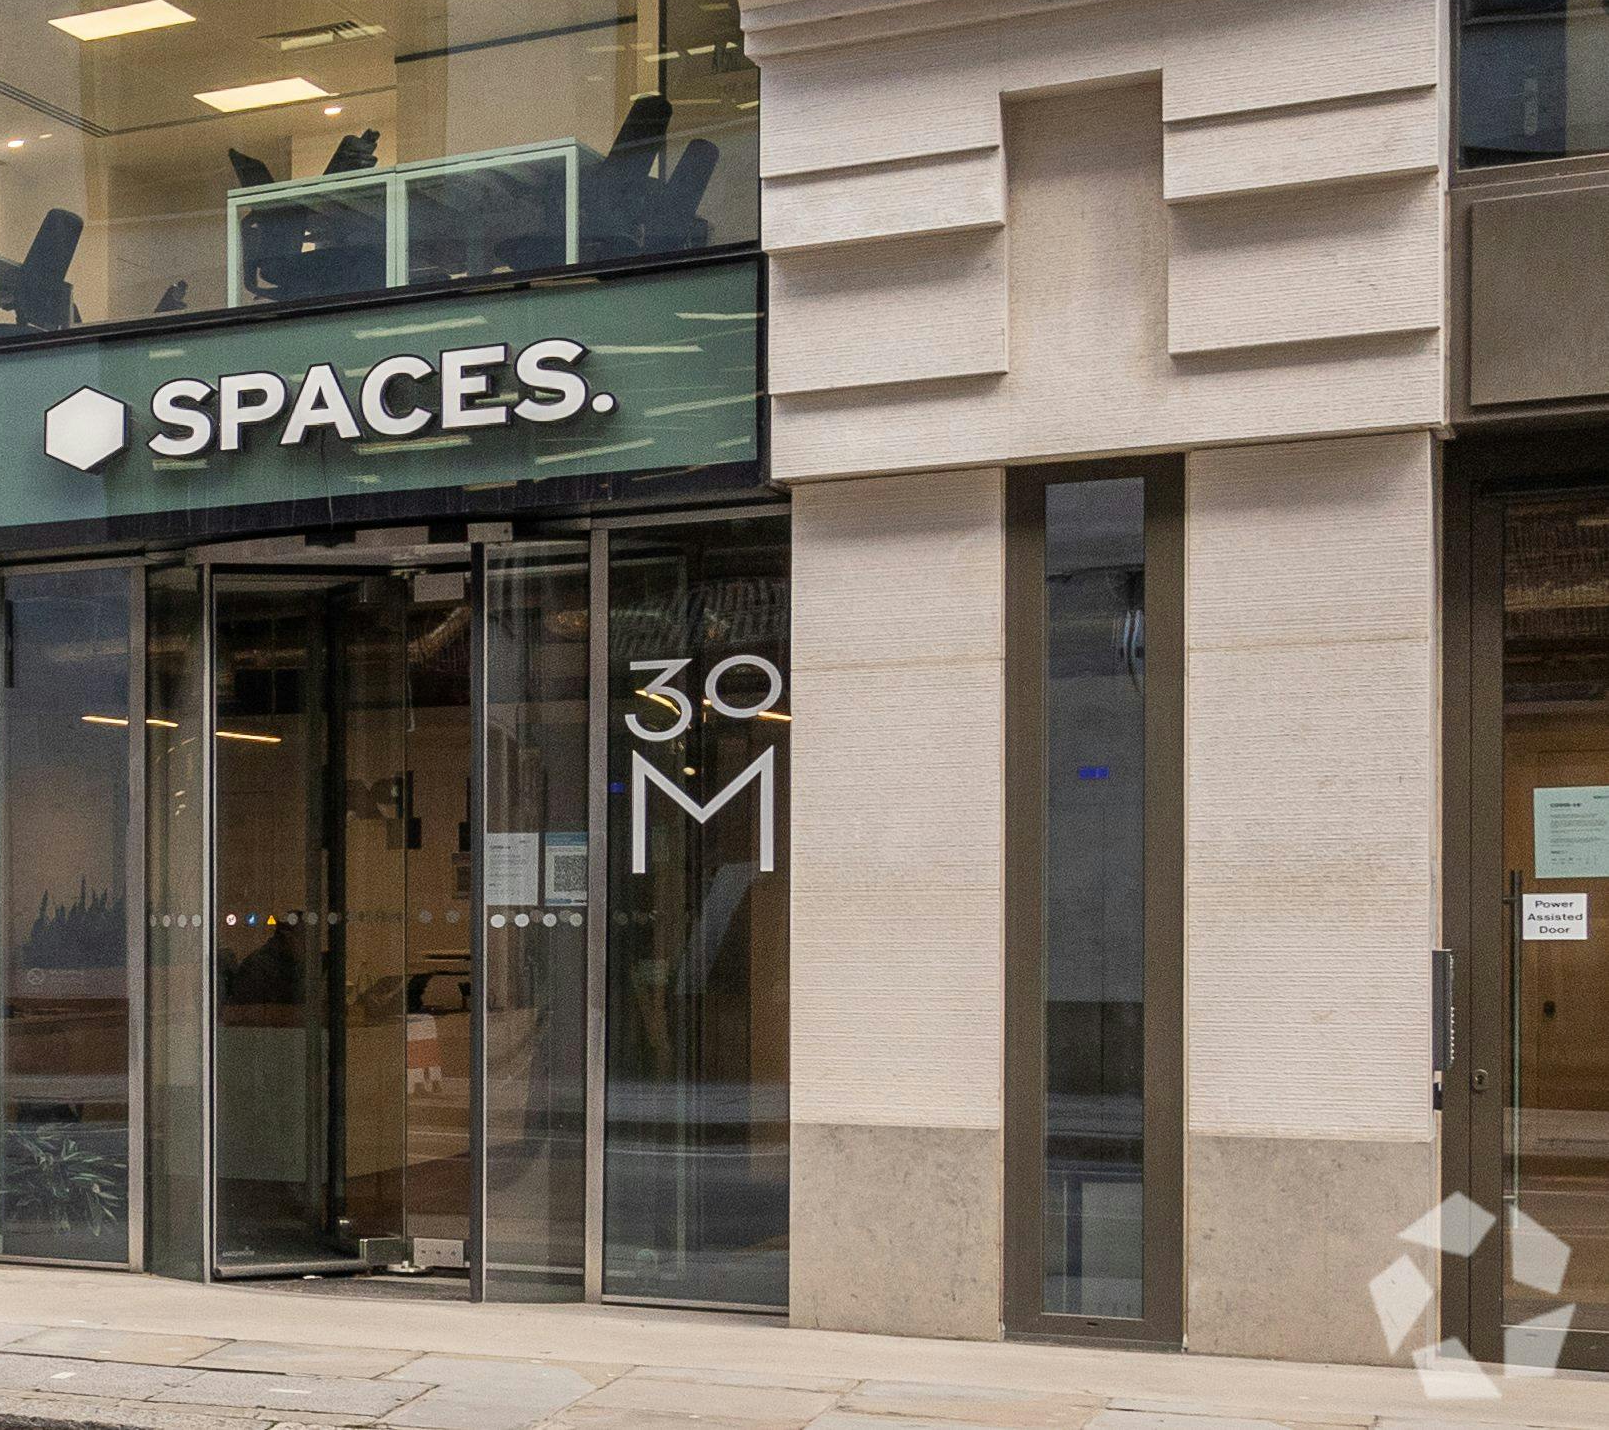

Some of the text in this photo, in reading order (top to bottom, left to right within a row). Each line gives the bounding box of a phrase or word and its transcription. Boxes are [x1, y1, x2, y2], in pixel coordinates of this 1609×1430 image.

[624, 654, 782, 742] 30
[632, 744, 774, 874] M
[1534, 900, 1575, 909] Power
[1527, 913, 1584, 921] Assisted
[1539, 925, 1571, 934] Door
